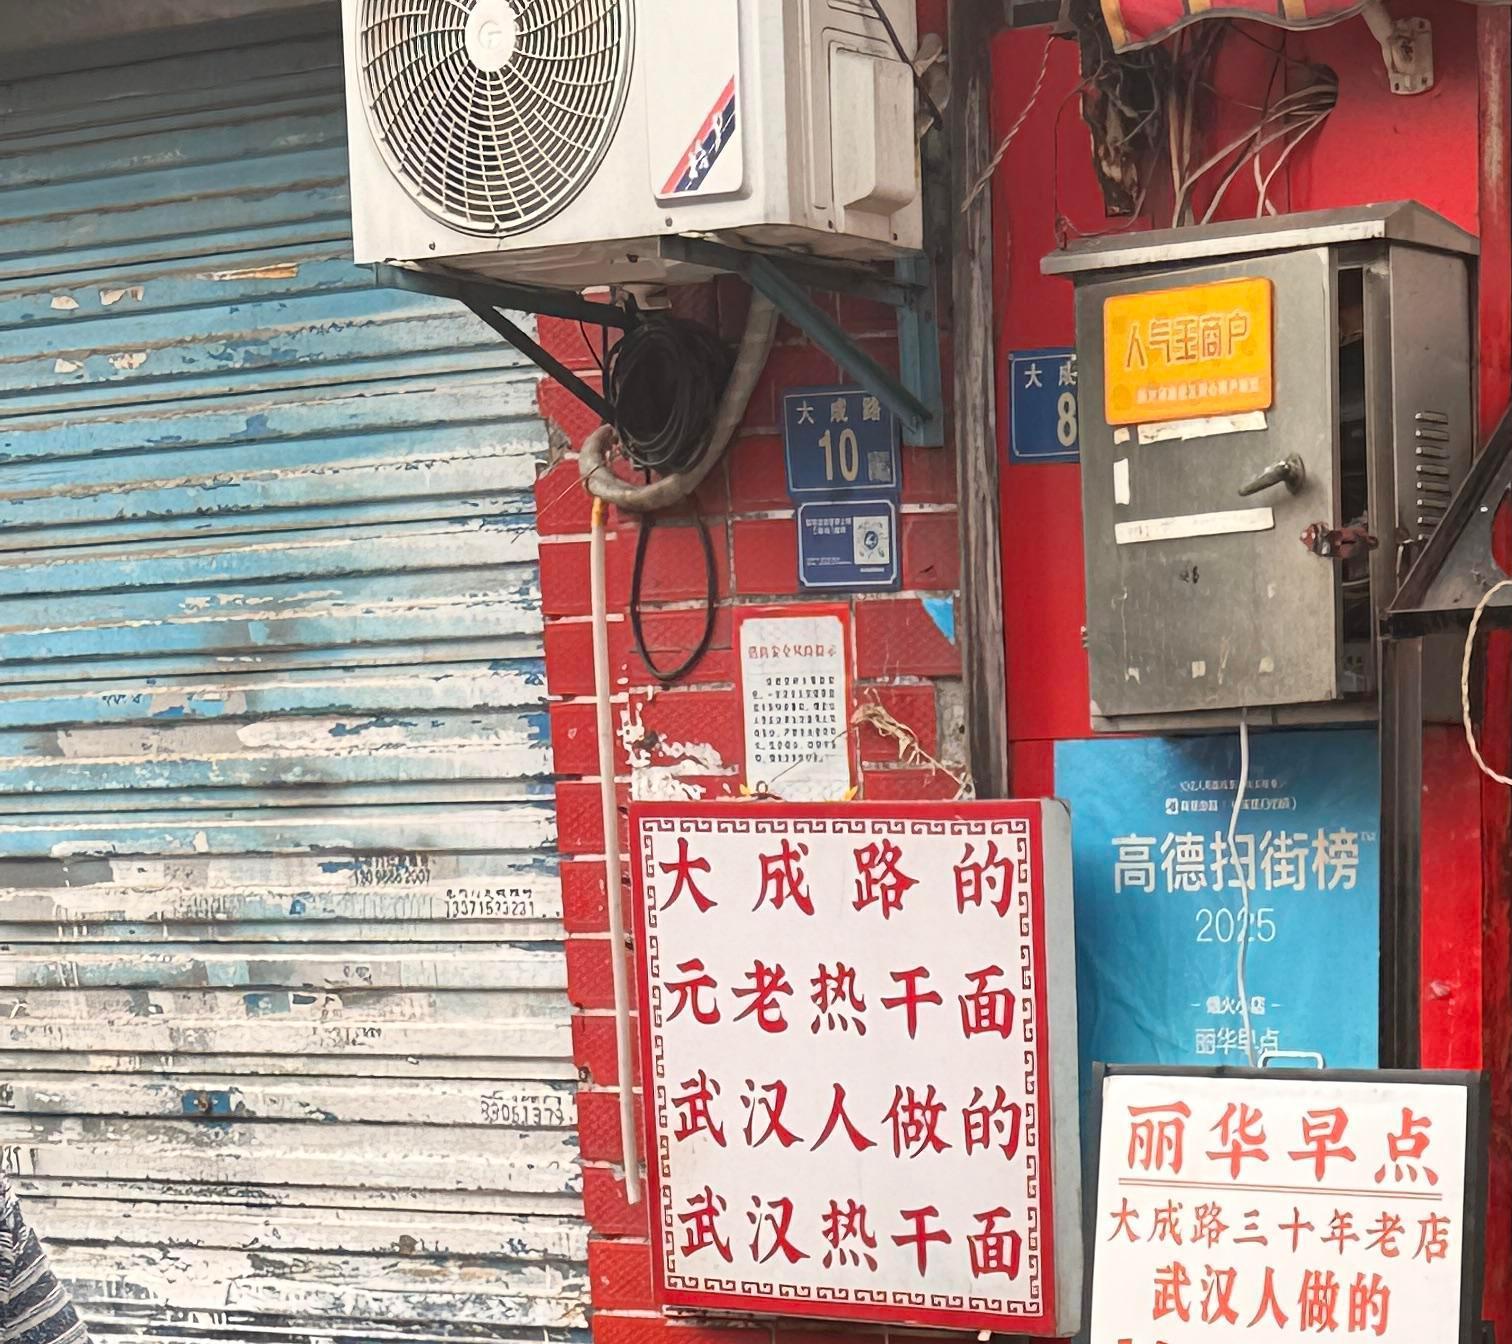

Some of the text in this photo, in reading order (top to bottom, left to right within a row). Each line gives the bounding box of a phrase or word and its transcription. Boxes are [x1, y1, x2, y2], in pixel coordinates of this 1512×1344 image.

[797, 397, 881, 425] 大成路
[818, 427, 859, 481] 10
[659, 838, 1015, 920] 大成路的
[1111, 827, 1360, 894] 高德扫街榜
[1195, 907, 1276, 943] 2025
[663, 958, 1016, 1041] 元老热干面
[671, 1070, 1022, 1161] 武汉人做的
[1127, 1101, 1438, 1187] 丽华早点
[677, 1185, 1023, 1281] 武汉热干面
[1107, 1197, 1452, 1264] 大成路三十年老店
[1153, 1261, 1390, 1336] 武汉人做的
